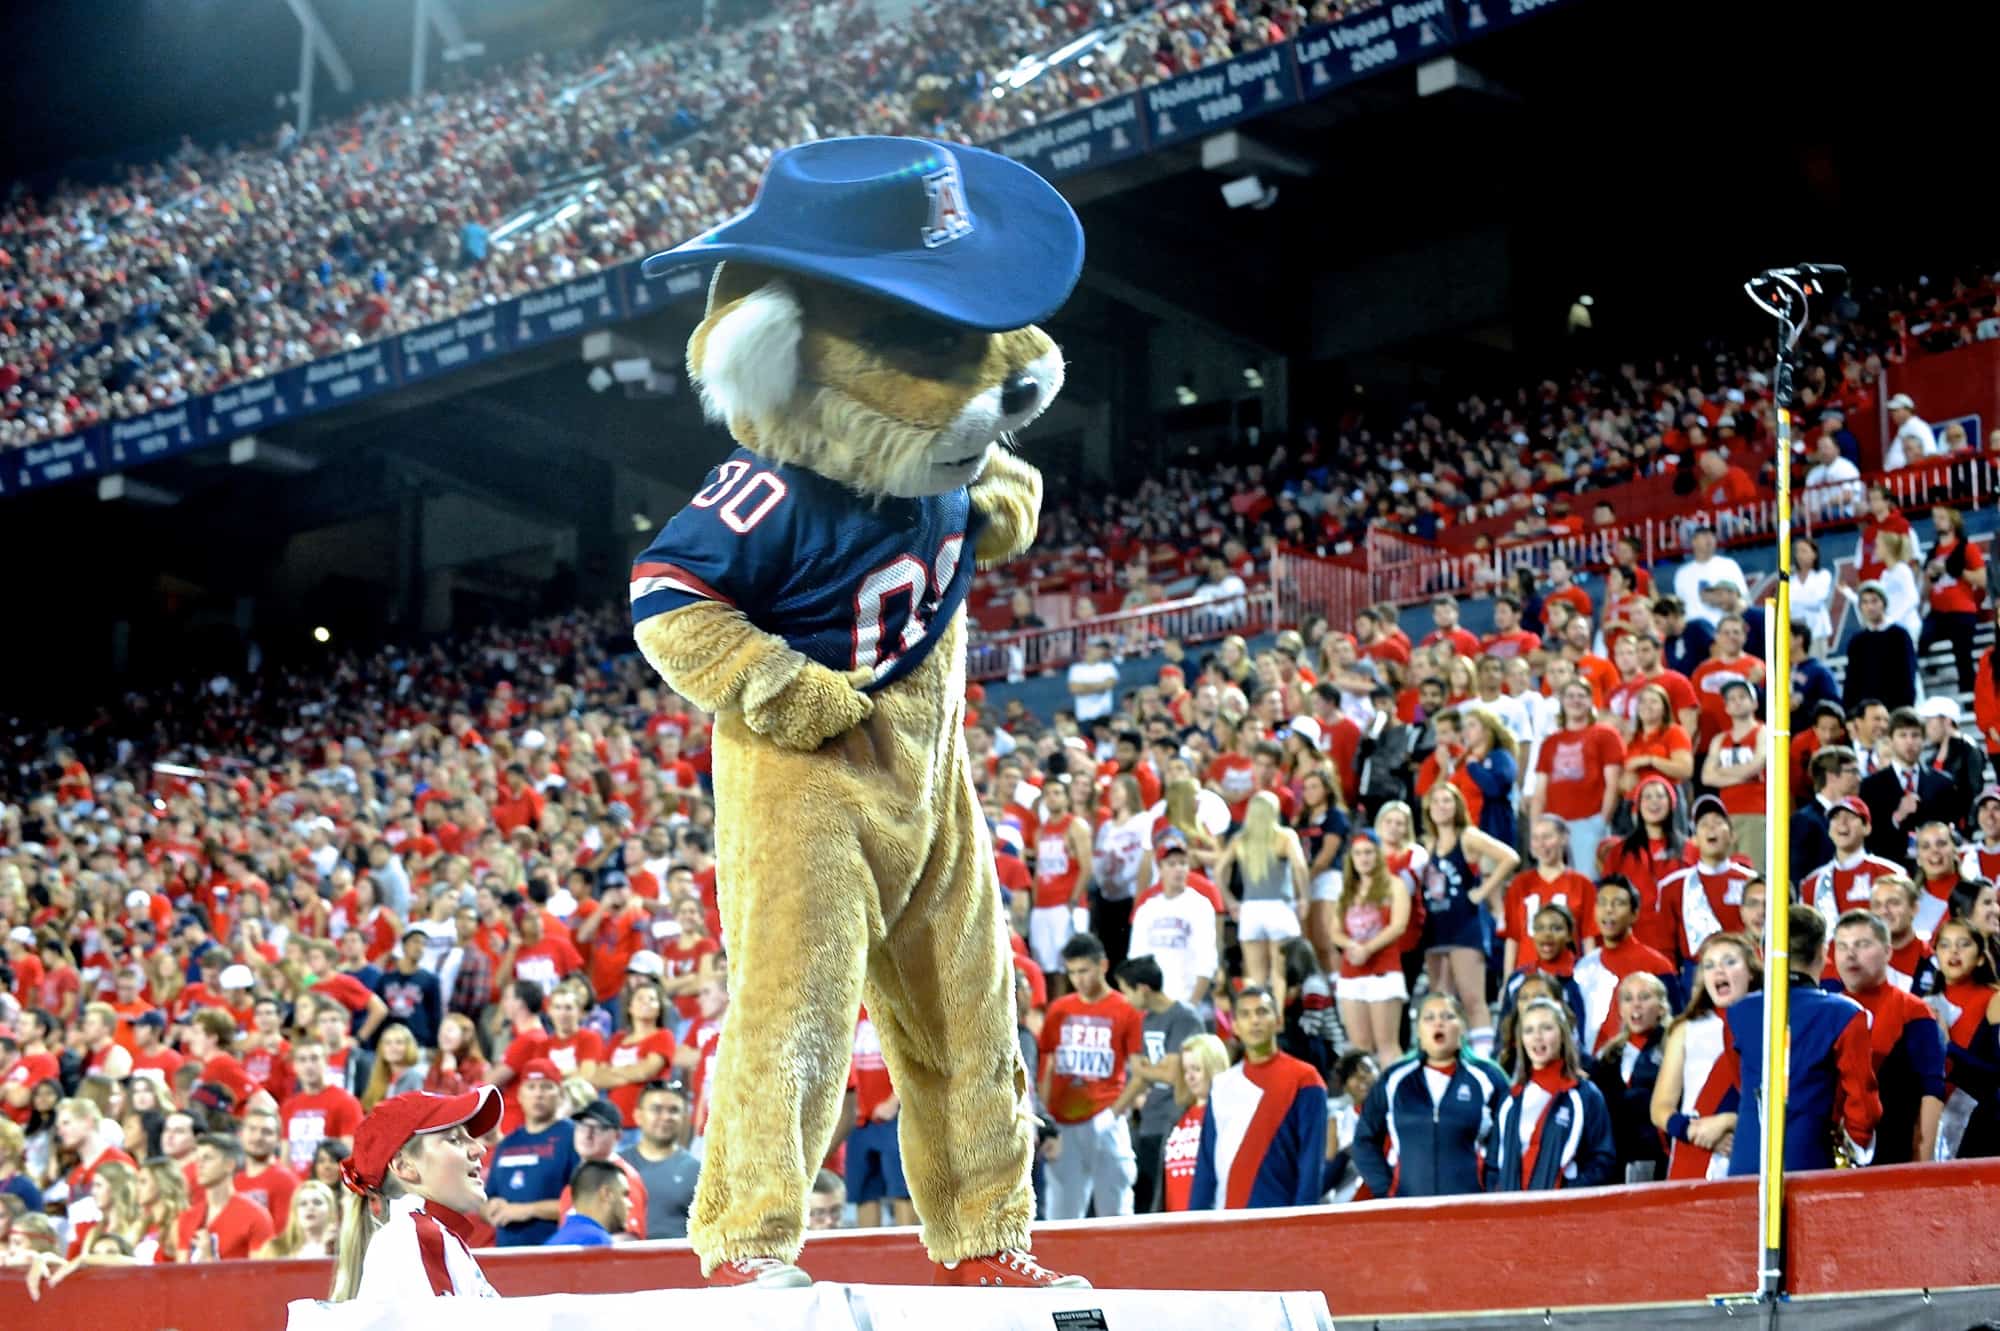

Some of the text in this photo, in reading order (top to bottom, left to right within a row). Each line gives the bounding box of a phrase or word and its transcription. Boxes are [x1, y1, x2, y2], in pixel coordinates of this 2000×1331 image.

[1296, 0, 1445, 64] Las Vegas Bowl
[1149, 49, 1280, 111] Holiday Bowl
[1092, 99, 1136, 131] Bowl
[921, 166, 975, 248] A
[565, 275, 606, 303] Bowl
[456, 311, 494, 338] Bowl
[691, 459, 787, 534] 00
[1524, 892, 1568, 938] 1
